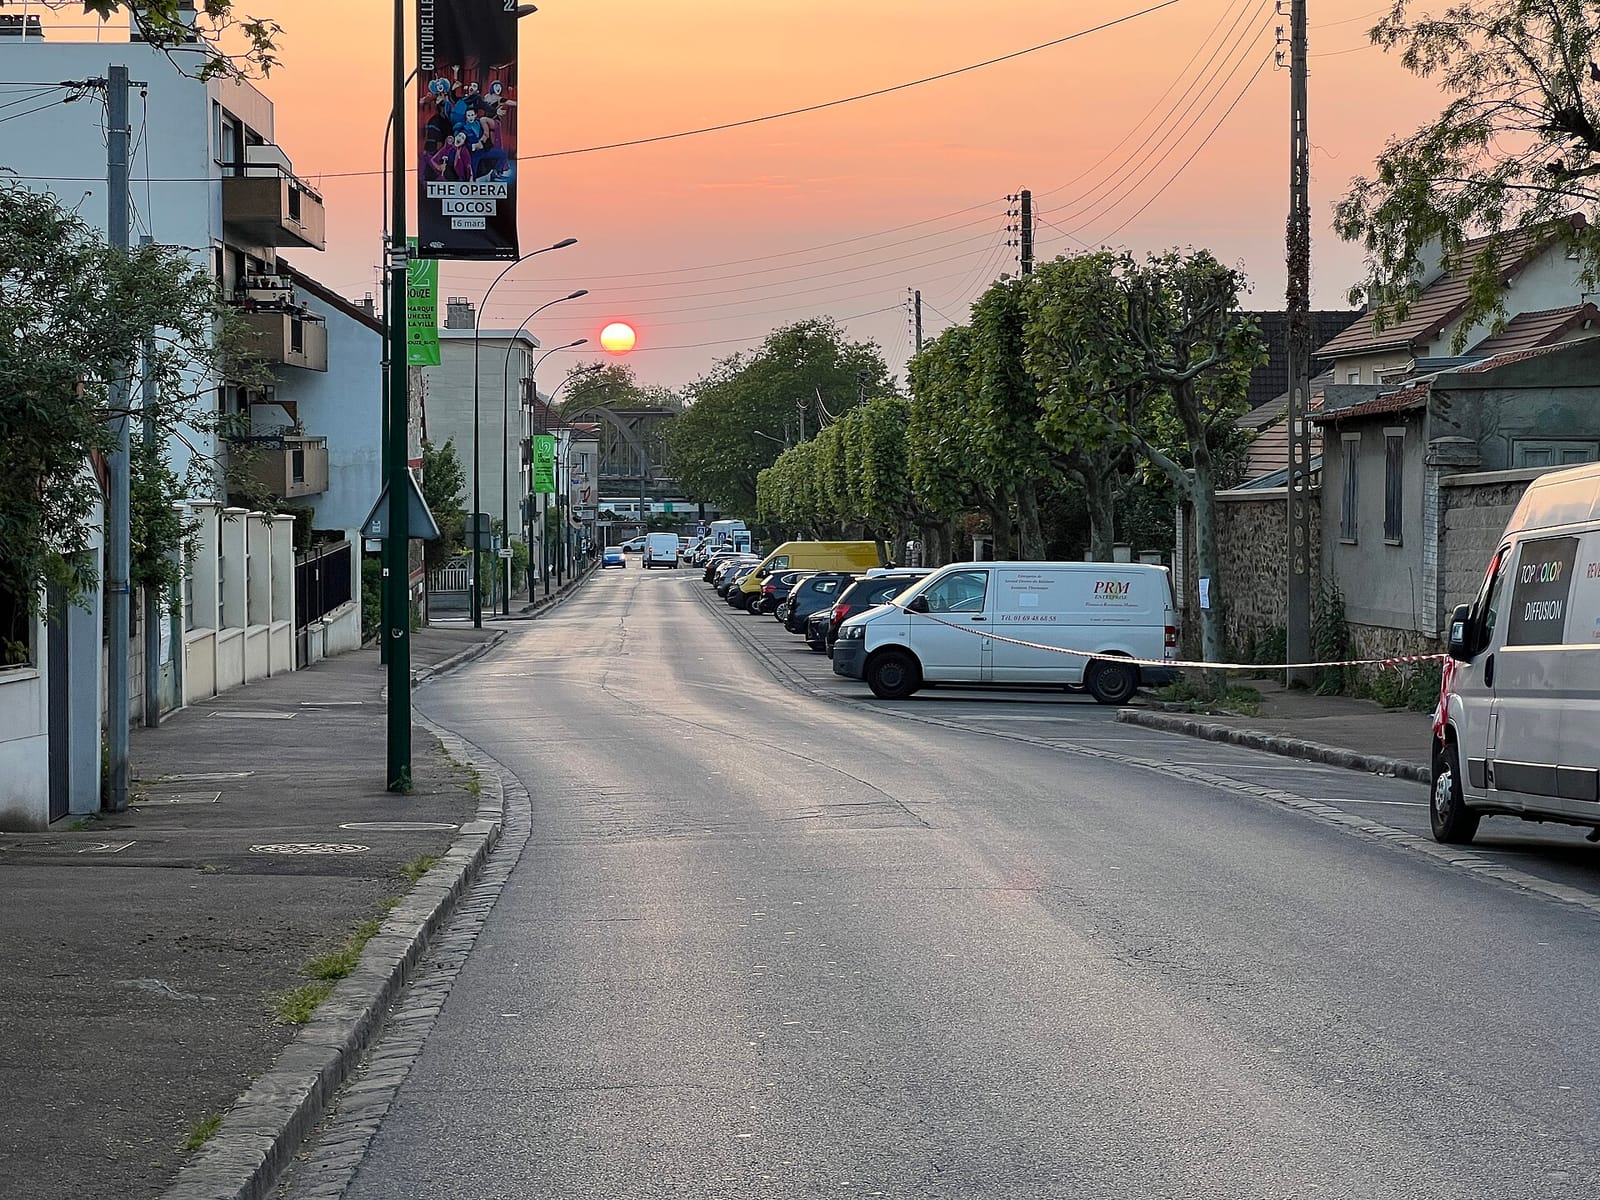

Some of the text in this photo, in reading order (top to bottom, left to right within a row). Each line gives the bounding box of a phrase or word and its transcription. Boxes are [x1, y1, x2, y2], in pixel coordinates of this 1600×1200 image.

[427, 184, 507, 196] THE OPERA
[447, 202, 493, 213] LOCOS
[452, 219, 486, 228] 16 mars
[1520, 561, 1562, 583] TOP COLOR
[1093, 581, 1130, 594] PRM
[1524, 600, 1562, 621] DIFFUSION
